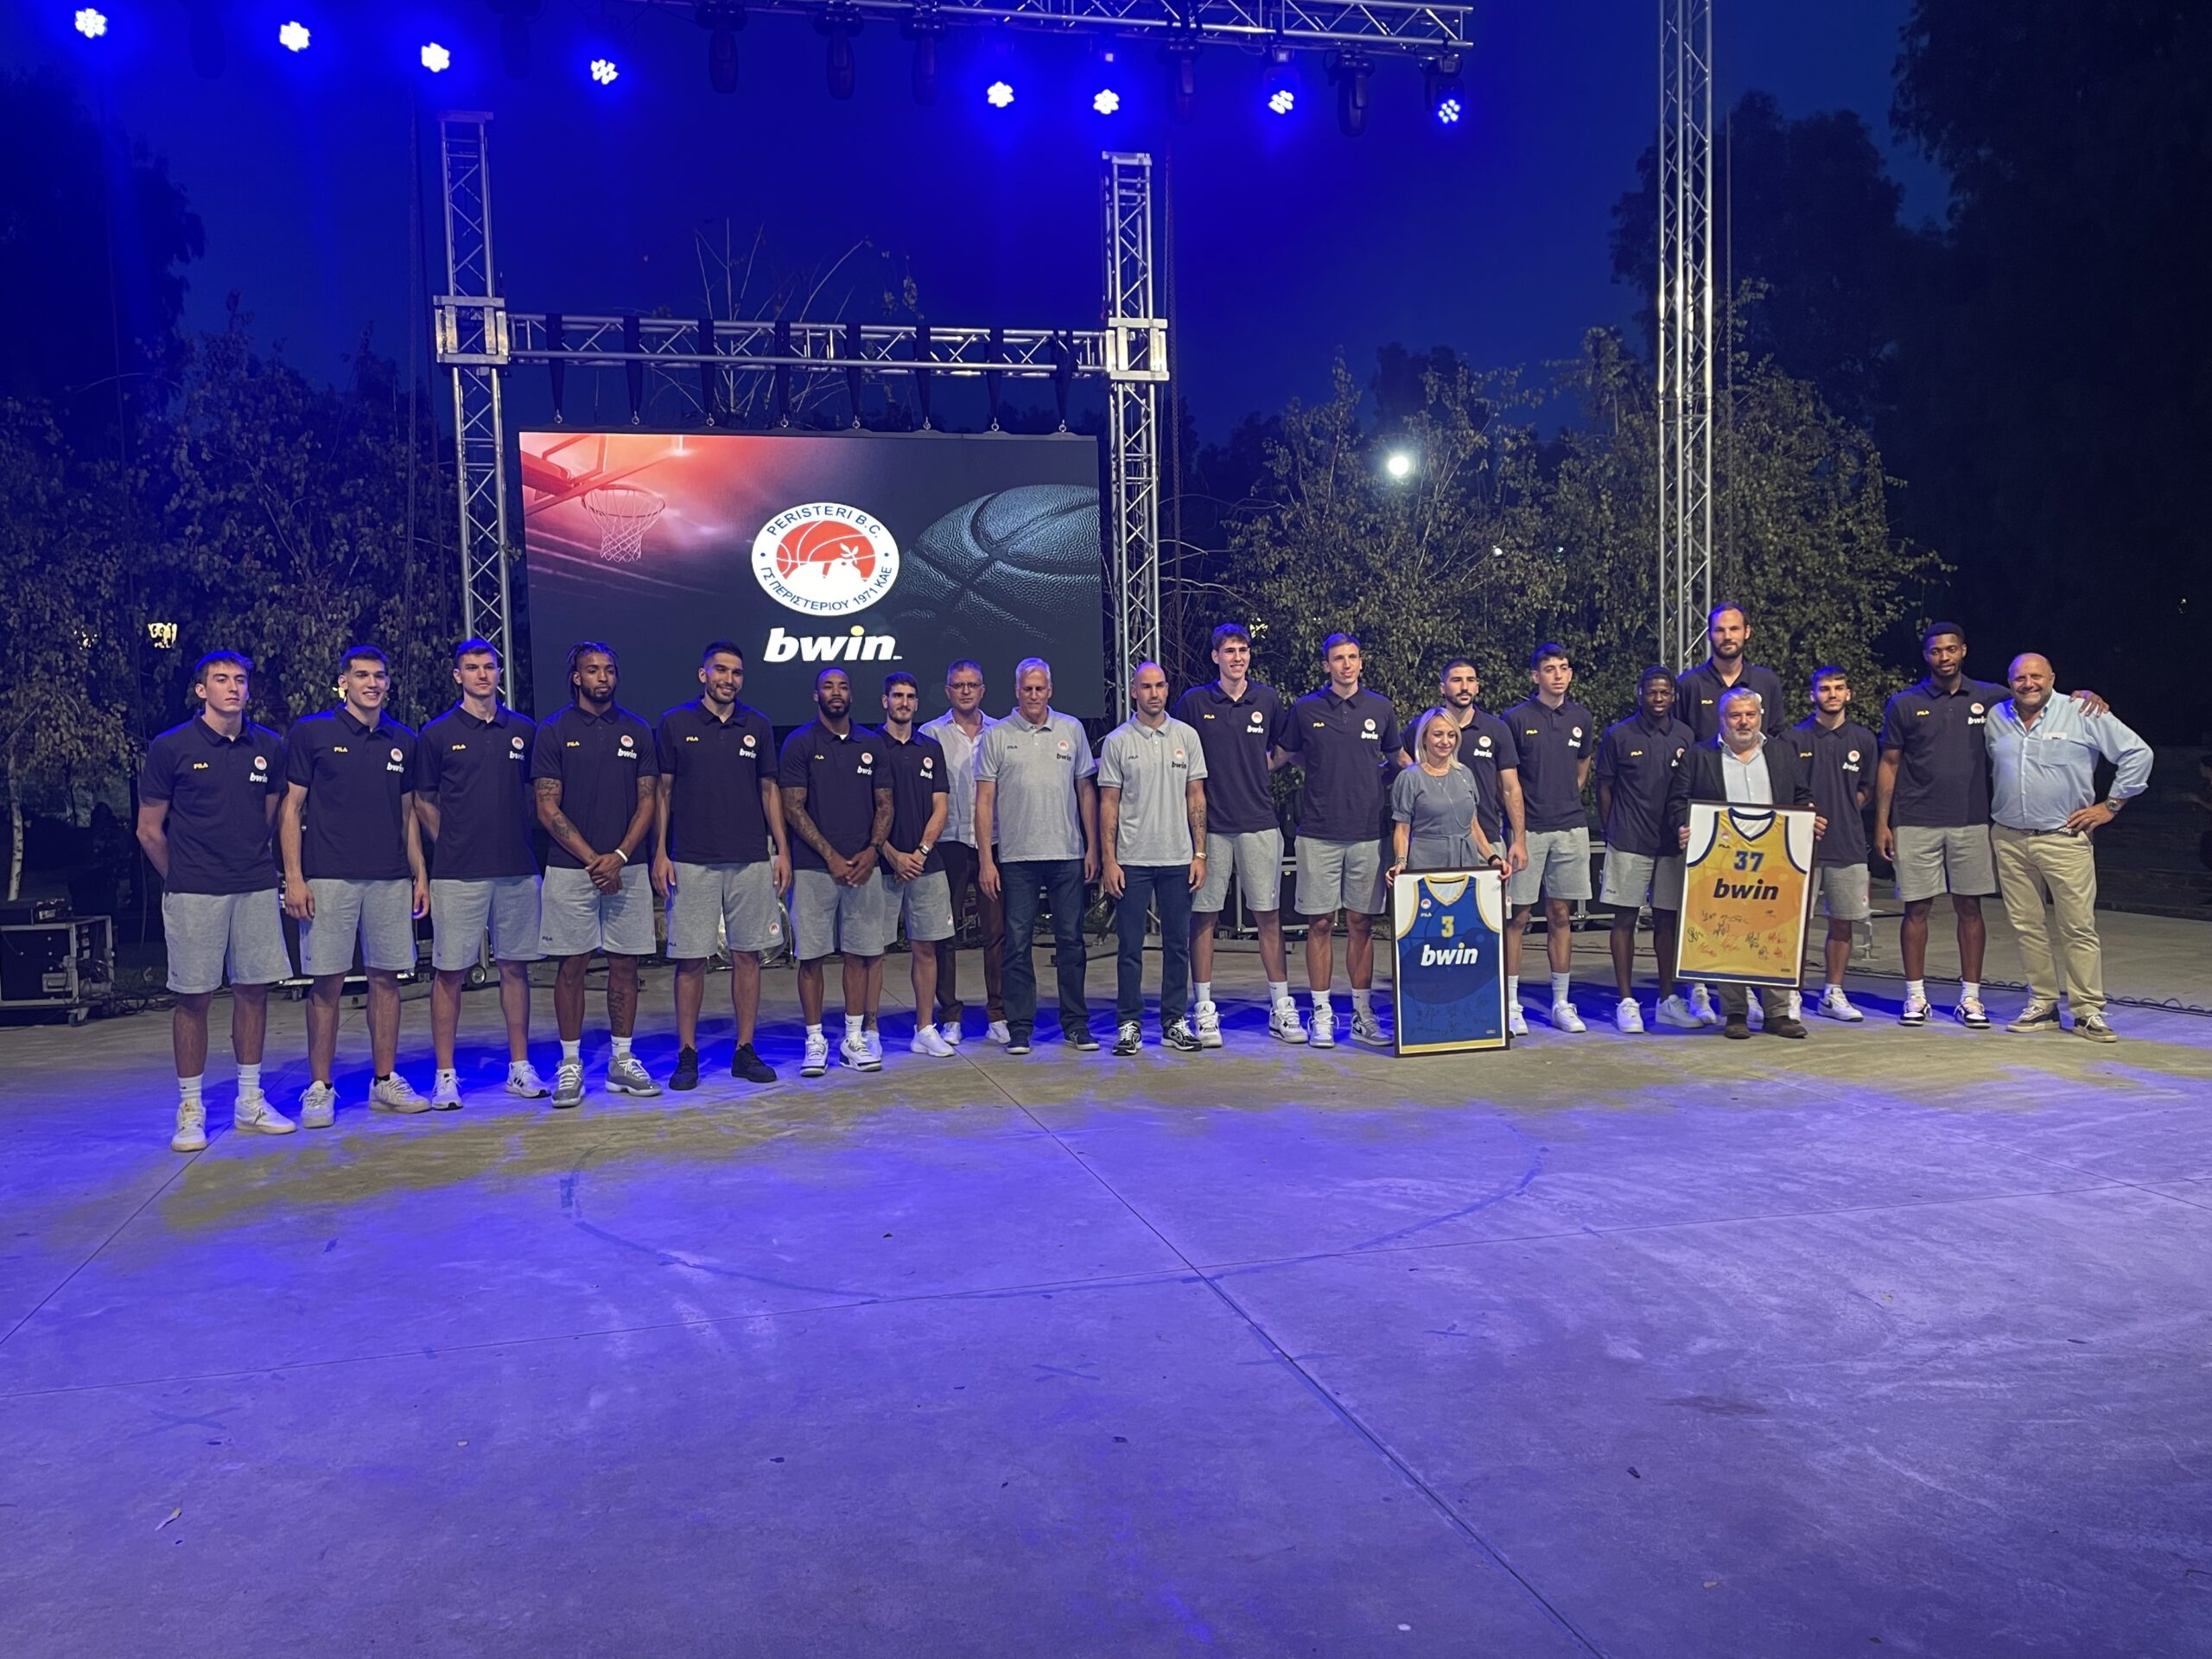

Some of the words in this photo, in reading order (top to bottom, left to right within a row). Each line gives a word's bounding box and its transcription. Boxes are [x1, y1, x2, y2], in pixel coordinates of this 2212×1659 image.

[766, 505, 853, 536] PERISTERI
[855, 514, 881, 538] B.C.
[852, 588, 878, 605] 1971
[763, 625, 897, 663] bwin
[1361, 731, 1378, 740] bwin
[618, 748, 637, 759] bwin
[1474, 748, 1492, 758] bwin
[1842, 762, 1859, 772] bwin
[1733, 850, 1764, 872] 37
[1713, 878, 1779, 900] bwin
[1441, 915, 1454, 938] 3
[1421, 942, 1478, 967] bwin
